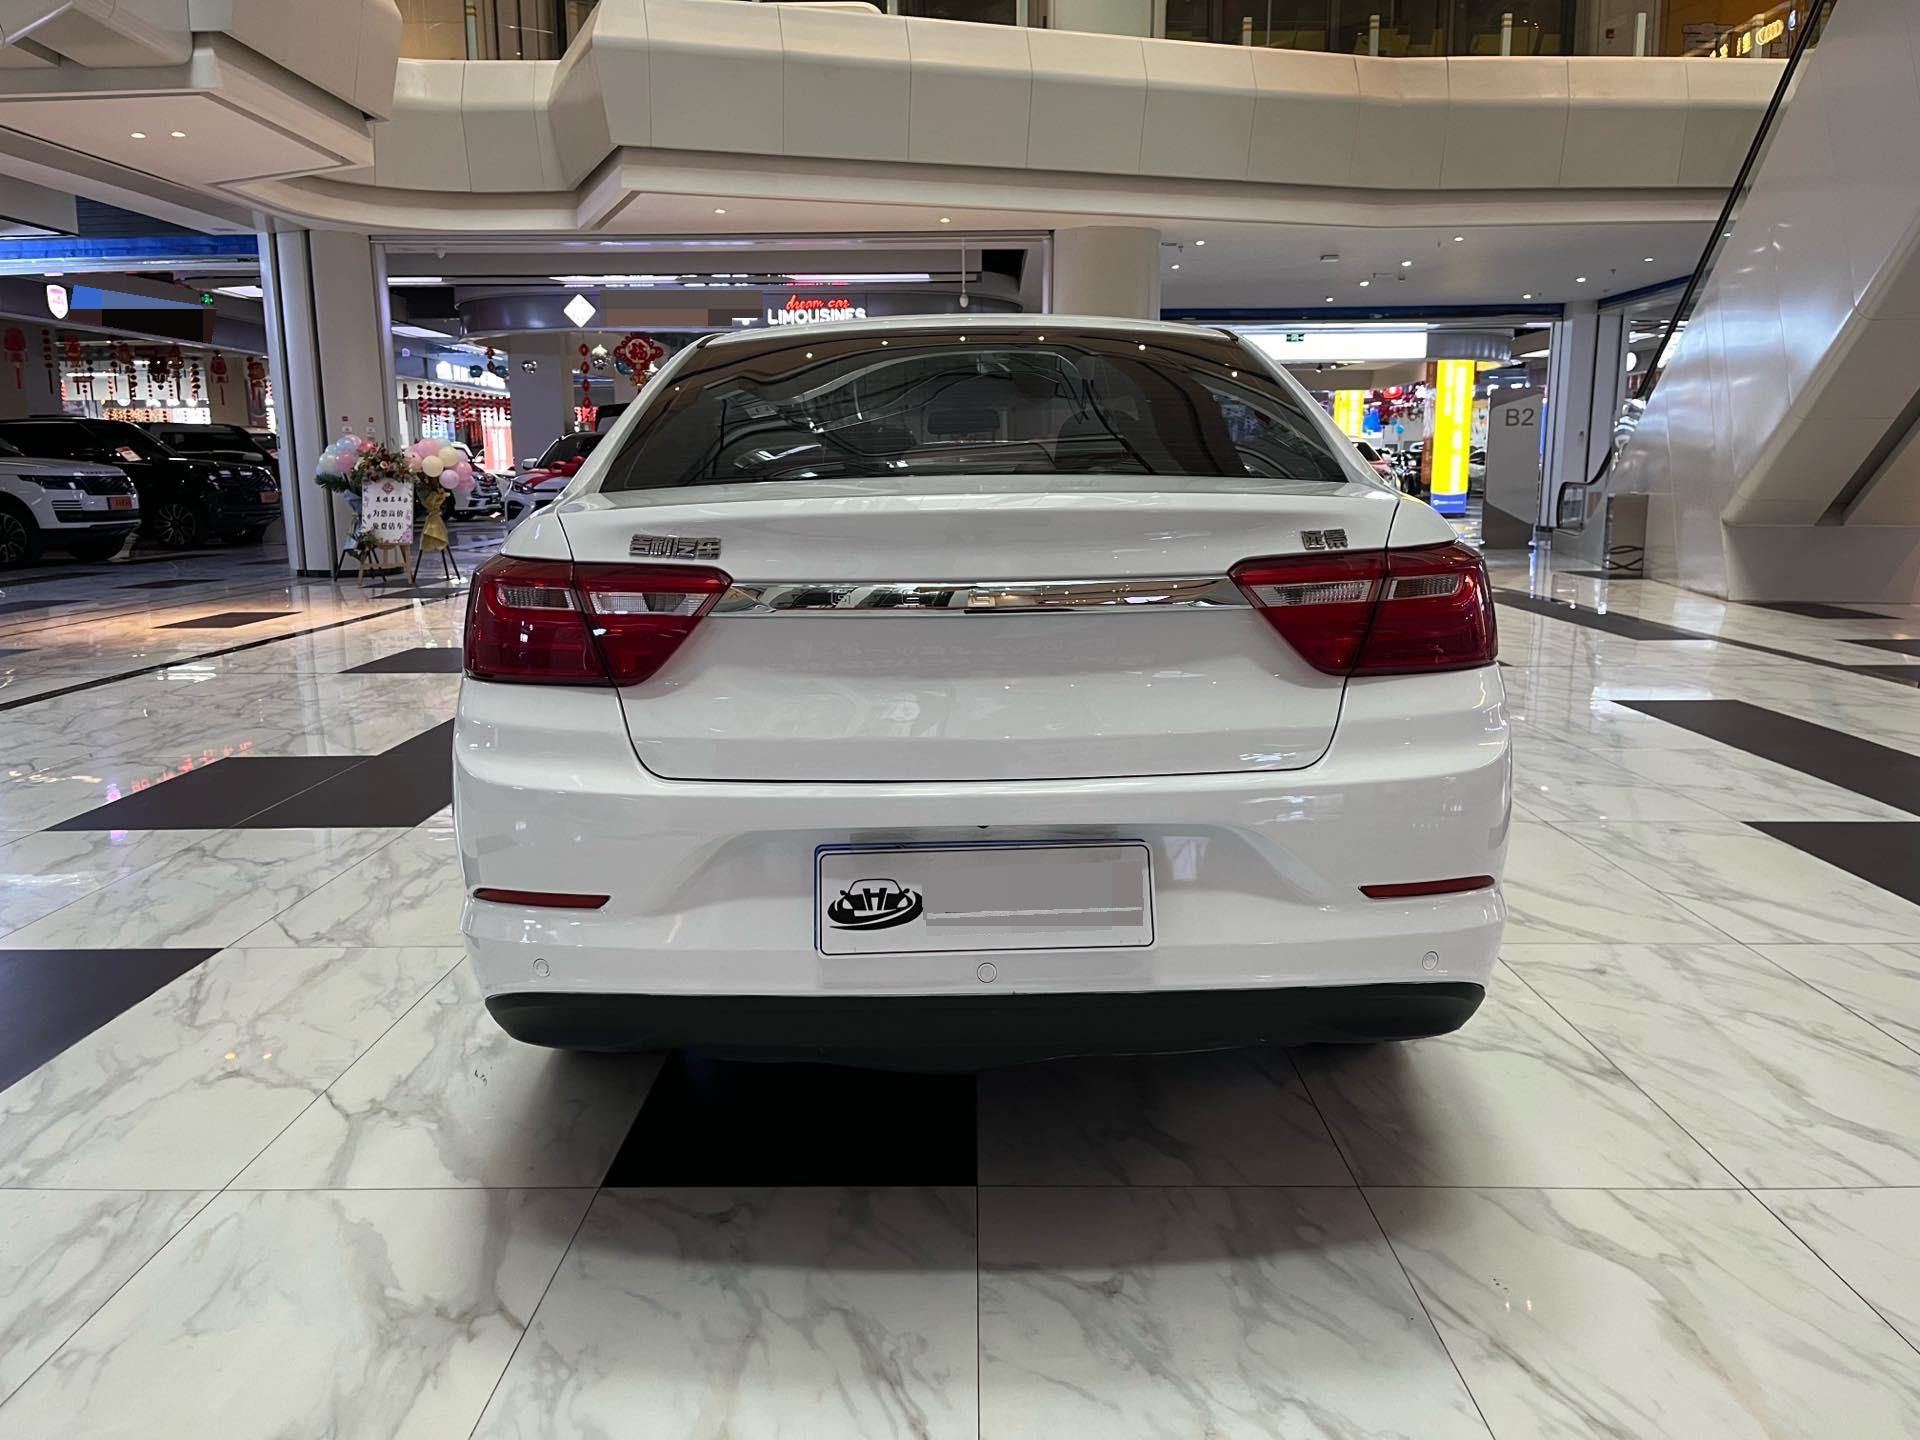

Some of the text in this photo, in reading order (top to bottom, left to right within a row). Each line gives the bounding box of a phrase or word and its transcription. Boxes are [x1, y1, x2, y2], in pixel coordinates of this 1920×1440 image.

[786, 295, 850, 310] dream car
[767, 308, 866, 325] LIMOUSINES
[1505, 408, 1534, 427] B2
